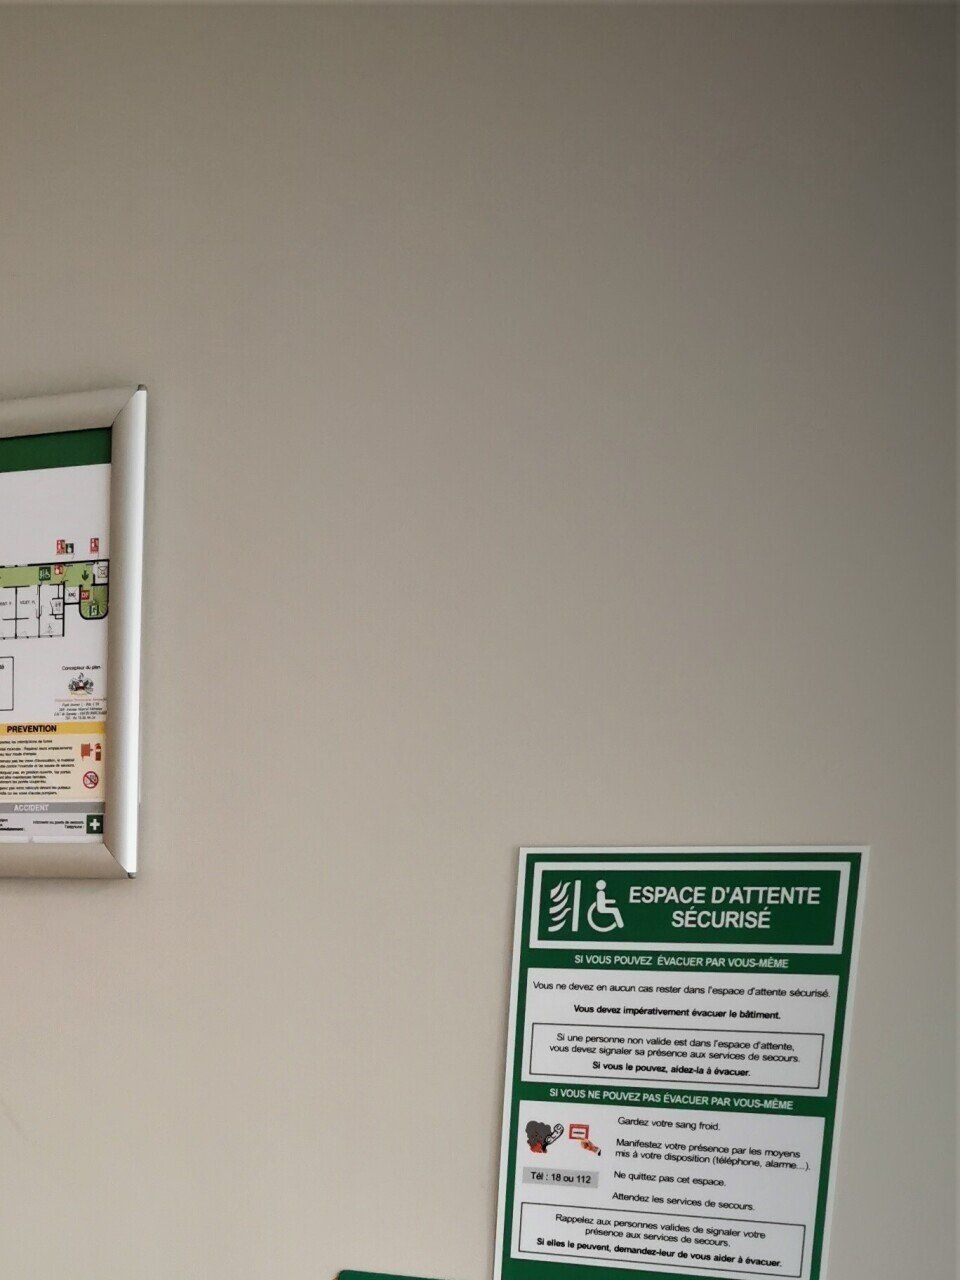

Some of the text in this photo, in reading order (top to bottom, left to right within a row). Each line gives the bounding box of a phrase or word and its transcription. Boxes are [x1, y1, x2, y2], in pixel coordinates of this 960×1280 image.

[7, 724, 56, 733] PREVENTION
[628, 885, 821, 904] ESPACE D'ATTENTE
[671, 905, 771, 928] SÉCURISÉ
[574, 954, 788, 968] SI VOUS POUVEZ ÉVACUER PAR VOUS-MÊME
[532, 981, 553, 989] Vous
[568, 982, 594, 990] devez
[655, 985, 681, 993] rester
[683, 985, 705, 994] dans
[707, 986, 745, 996] l'espace
[747, 987, 787, 997] d'attente
[789, 988, 831, 998] sécurisé.
[573, 1004, 781, 1019] Vous devez impérativement évacuer le bâtiment.
[549, 1088, 793, 1109] SI VOUS NE POUVEZ PAS ÉVACUER PAR VOUS-MÊME
[617, 1116, 720, 1131] Gardez votre sang froid.
[530, 1171, 543, 1180] Tél
[550, 1173, 561, 1181] 18
[576, 1174, 591, 1184] 112
[613, 1170, 726, 1187] Ne quittez pas cet espace.
[612, 1192, 755, 1210] Attendez les services de secours.
